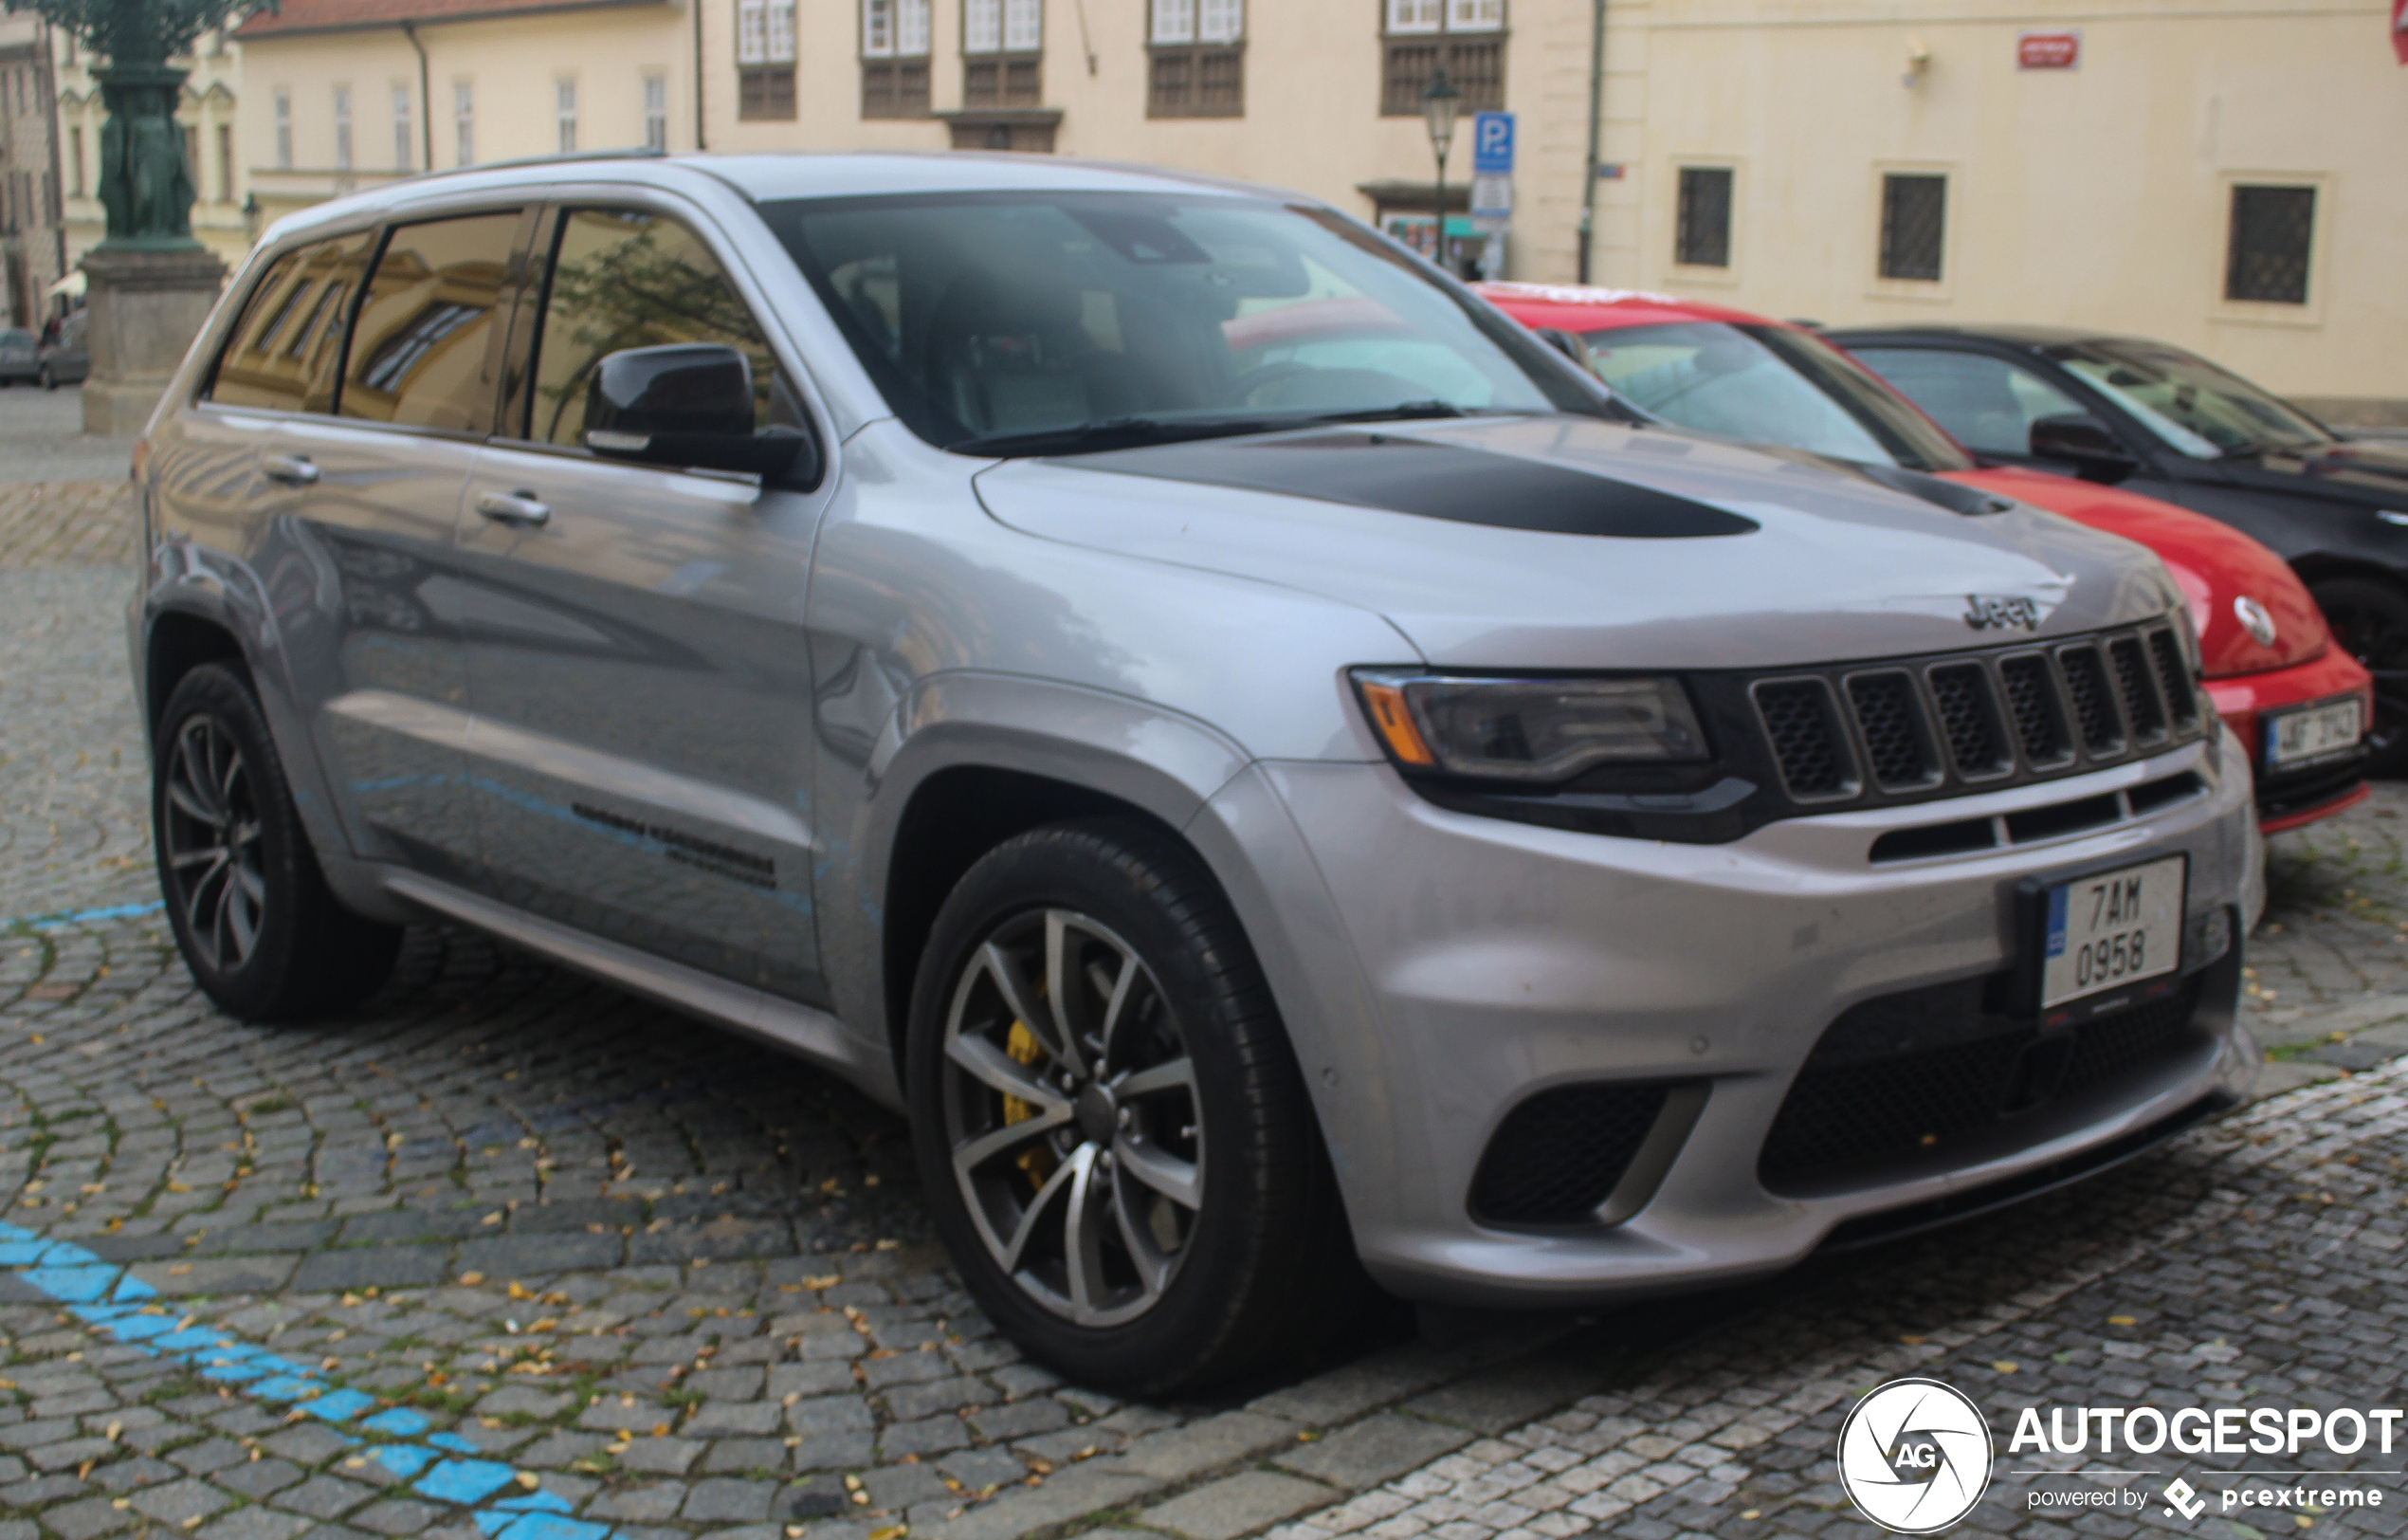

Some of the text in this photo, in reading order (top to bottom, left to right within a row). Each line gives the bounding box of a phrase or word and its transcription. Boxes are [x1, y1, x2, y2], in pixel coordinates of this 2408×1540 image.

[1483, 119, 1506, 153] P
[1963, 594, 2037, 632] Jeep
[2090, 875, 2142, 930] 7AM
[2075, 929, 2145, 986] 0958
